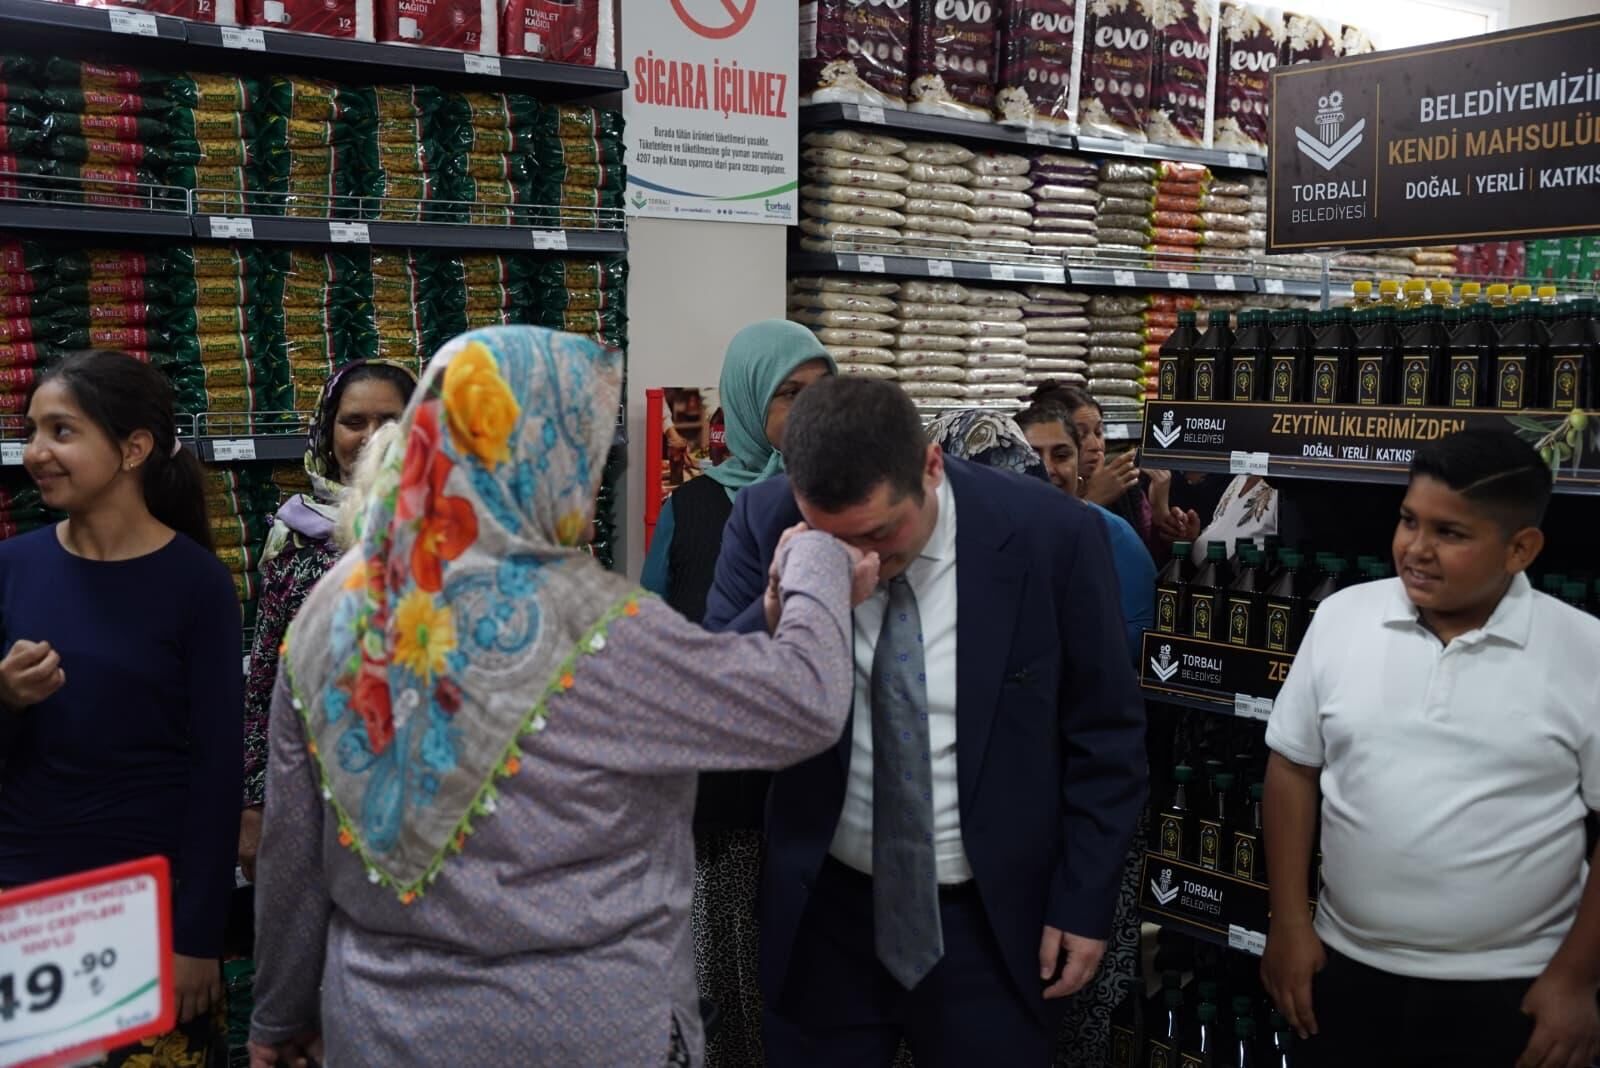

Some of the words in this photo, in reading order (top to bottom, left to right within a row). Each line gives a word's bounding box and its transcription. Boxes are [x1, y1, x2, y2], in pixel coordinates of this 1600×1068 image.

[525, 8, 560, 21] TUVALET
[934, 0, 992, 24] evo
[338, 17, 351, 29] 12
[1030, 12, 1074, 34] evo
[466, 31, 477, 43] 12
[1095, 26, 1149, 50] evo
[583, 47, 592, 57] 12
[1170, 40, 1210, 60] evo
[1231, 50, 1277, 72] evo
[634, 49, 709, 110] SİGARA
[714, 58, 787, 119] İÇİLMEZ
[654, 126, 675, 138] Burada
[676, 128, 691, 140] tütün
[692, 130, 715, 142] ürünleri
[715, 132, 746, 144] tüketilmesi
[639, 139, 673, 152] Tüketenlere
[674, 144, 681, 153] ve
[682, 143, 720, 156] tüketilmesine
[721, 148, 731, 159] göz
[732, 149, 749, 159] yuman
[1388, 128, 1457, 165] KENDİ
[636, 152, 651, 164] 4207
[652, 155, 668, 167] sayılı
[669, 156, 688, 166] Kanun
[689, 158, 713, 169] uyarınca
[714, 159, 728, 169] idari
[728, 162, 741, 173] para
[742, 163, 760, 173] cezası
[1292, 179, 1367, 202] TORBALI
[1406, 175, 1461, 199] DOĞAL
[1476, 168, 1524, 194] YERLİ
[1292, 204, 1366, 223] BELEDİYESİ
[1186, 418, 1226, 431] TORBALI
[1184, 433, 1224, 444] BELEDİYESİ
[1303, 442, 1334, 458] DOĞAL
[1342, 445, 1369, 460] YERLİ
[1182, 654, 1222, 671] TORBALI
[1181, 669, 1222, 684] BELEDİYESİ
[1183, 880, 1223, 902] TORBALI
[1180, 895, 1221, 915] BELEDİYESİ
